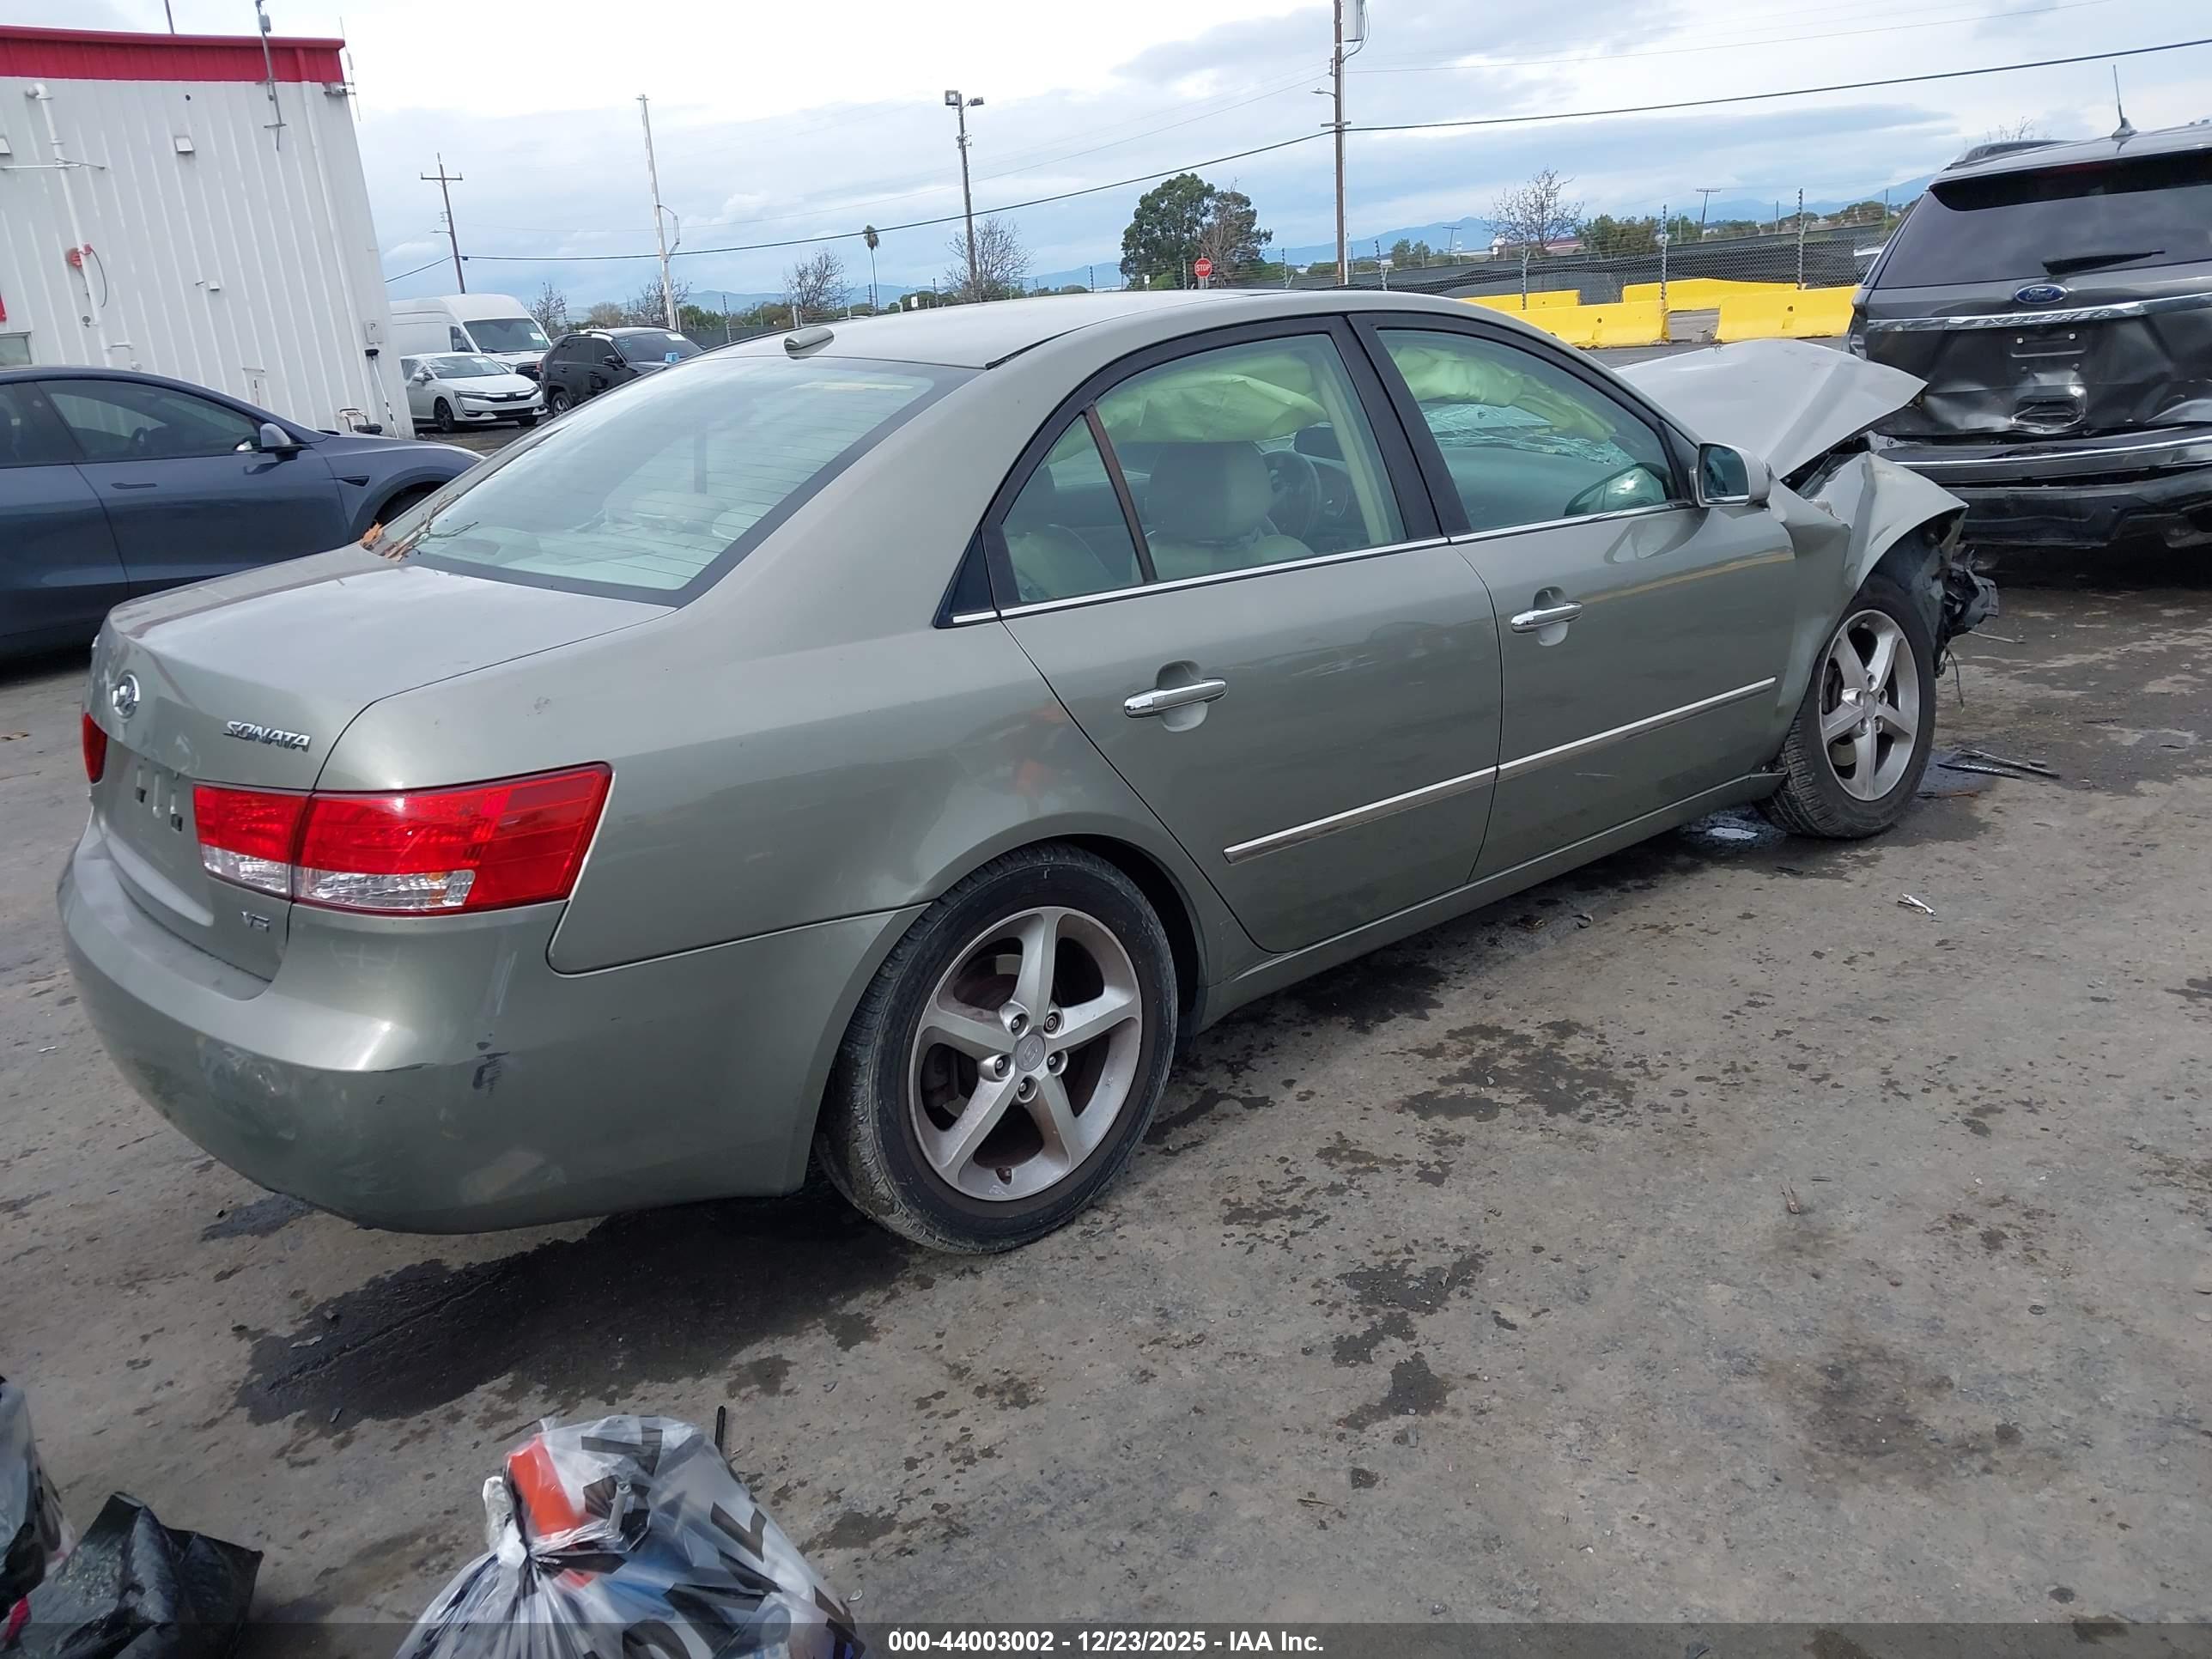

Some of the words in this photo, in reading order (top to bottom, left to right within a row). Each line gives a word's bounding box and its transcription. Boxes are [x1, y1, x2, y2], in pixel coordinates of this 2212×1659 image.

[1196, 264, 1211, 272] STOP
[1972, 309, 2112, 327] EXPLORER
[223, 720, 311, 750] SONATA
[240, 911, 270, 931] V6
